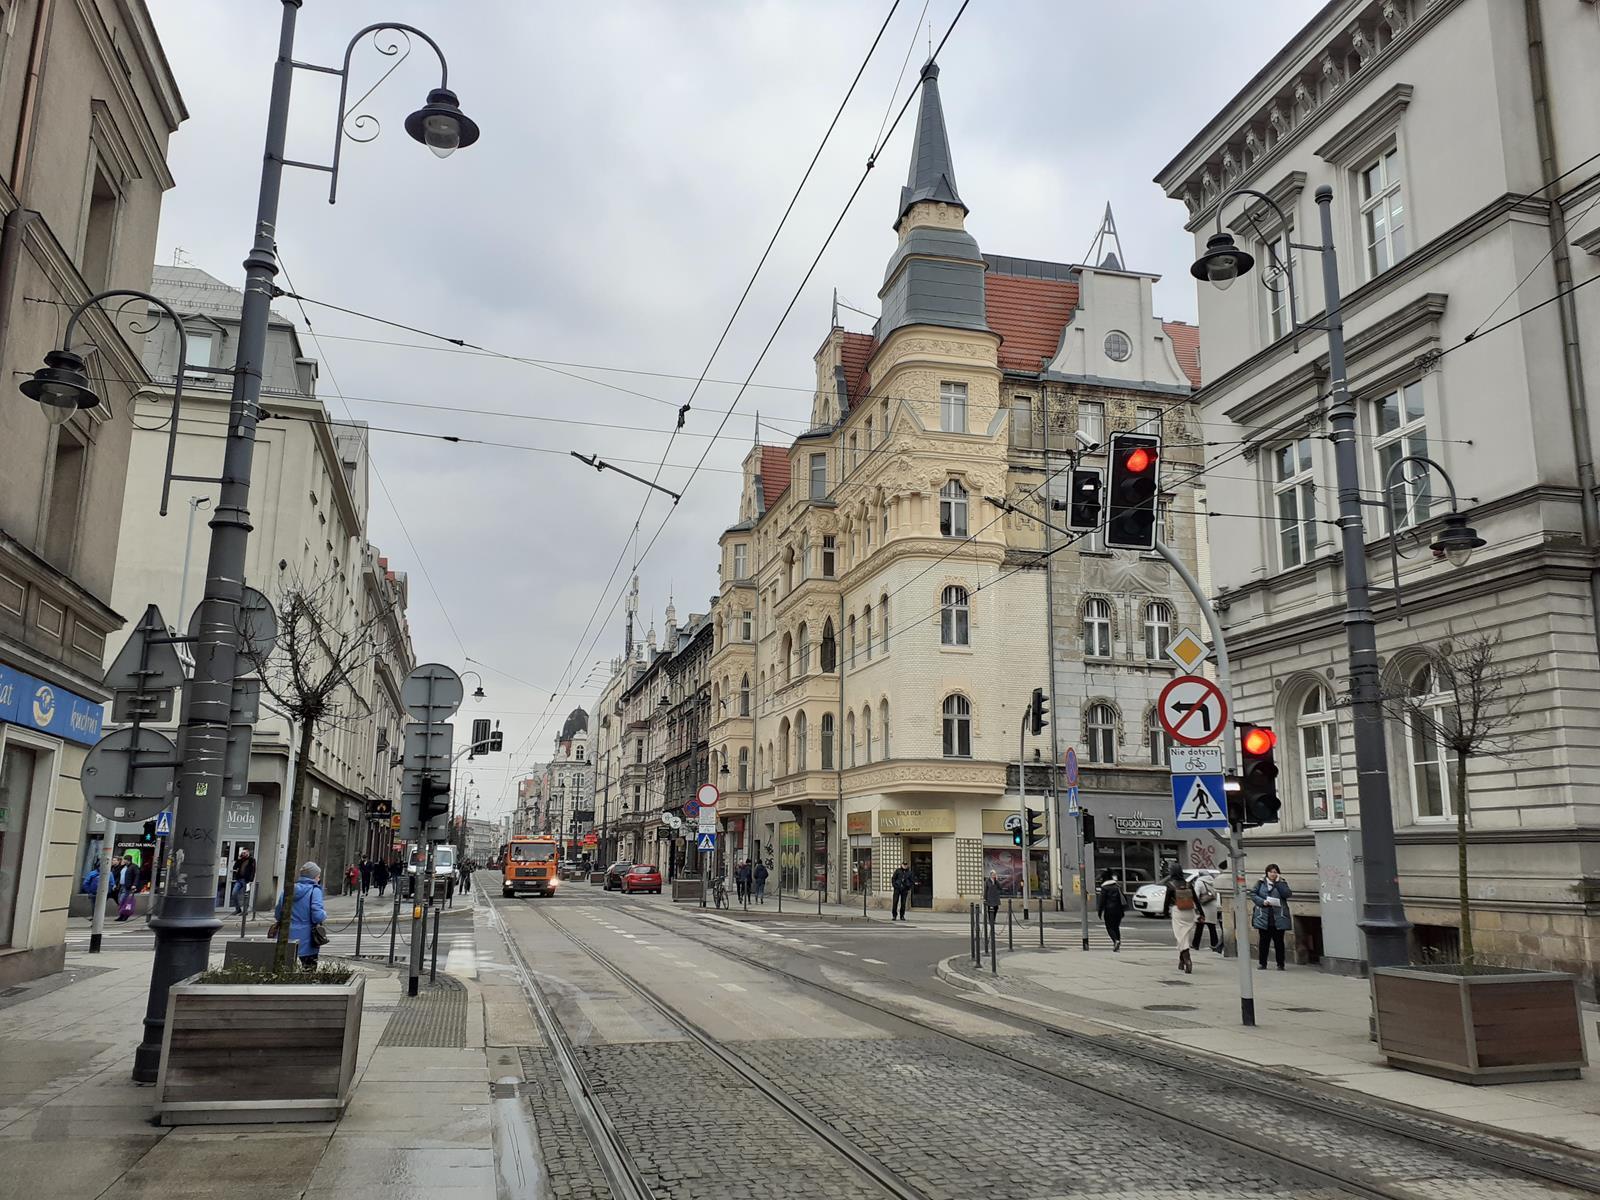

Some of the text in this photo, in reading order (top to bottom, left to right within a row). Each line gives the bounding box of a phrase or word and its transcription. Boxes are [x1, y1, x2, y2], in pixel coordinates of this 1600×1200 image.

[1170, 748, 1219, 758] Nie dotyczy
[226, 811, 256, 824] Moda
